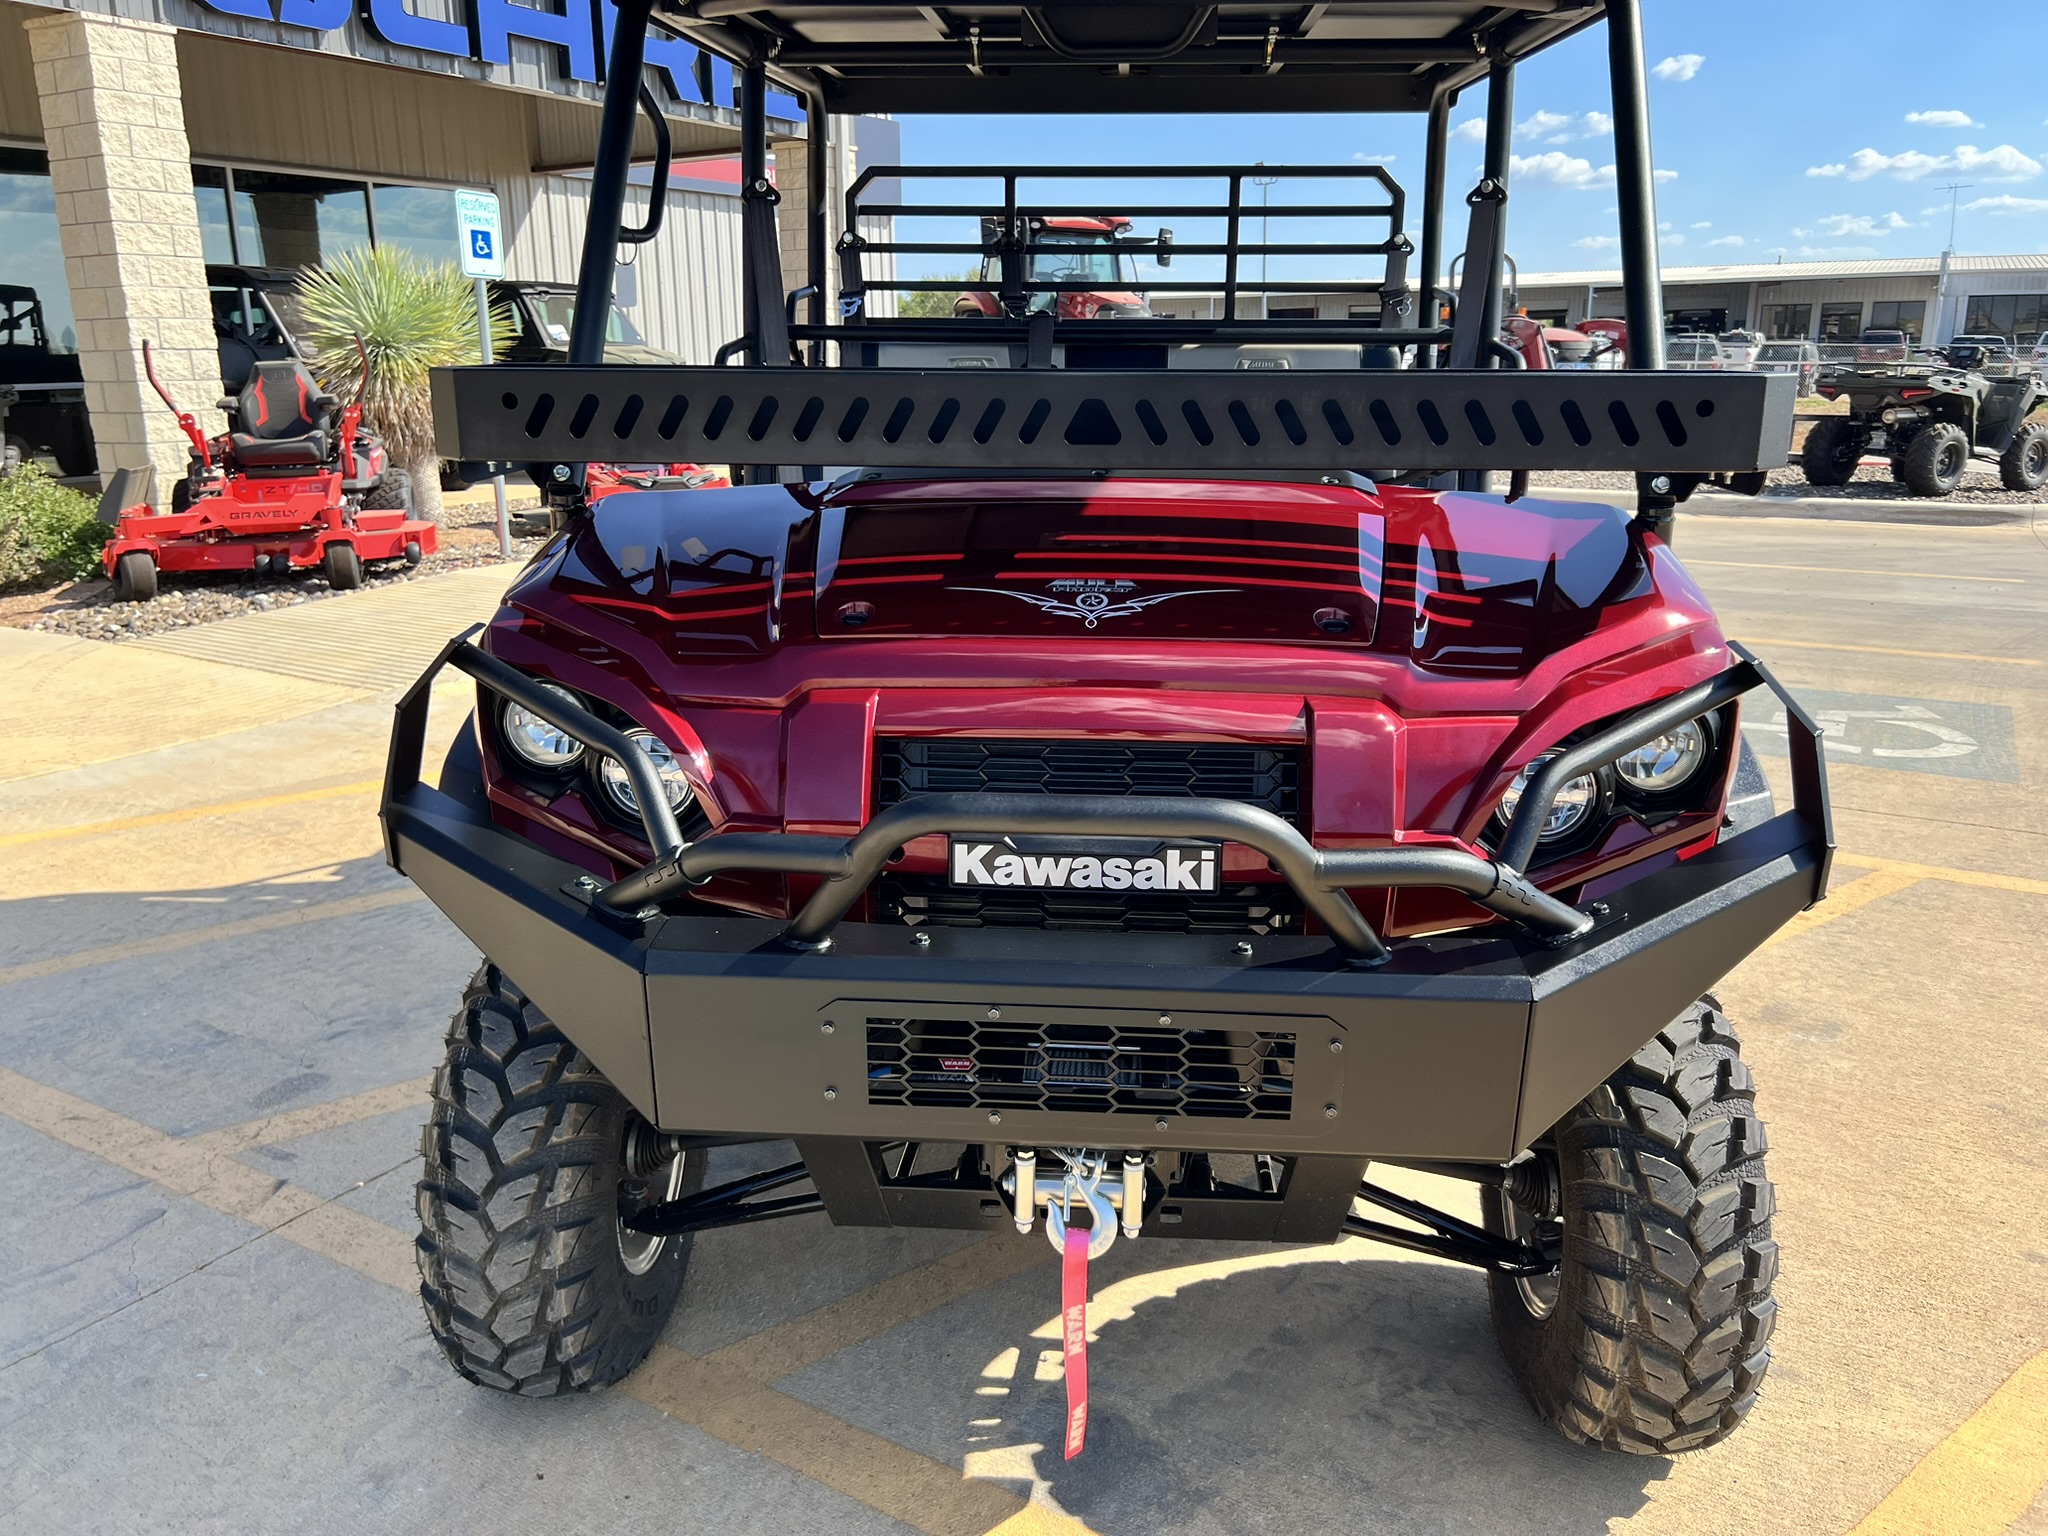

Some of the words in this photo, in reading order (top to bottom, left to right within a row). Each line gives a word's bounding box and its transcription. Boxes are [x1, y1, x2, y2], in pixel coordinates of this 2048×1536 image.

[460, 198, 497, 214] RESERVED
[463, 213, 495, 228] PARKING
[229, 509, 299, 520] GRAVELY
[953, 842, 1216, 892] Kawasaki
[1065, 1303, 1084, 1358] WARN
[1068, 1401, 1086, 1450] WARN
